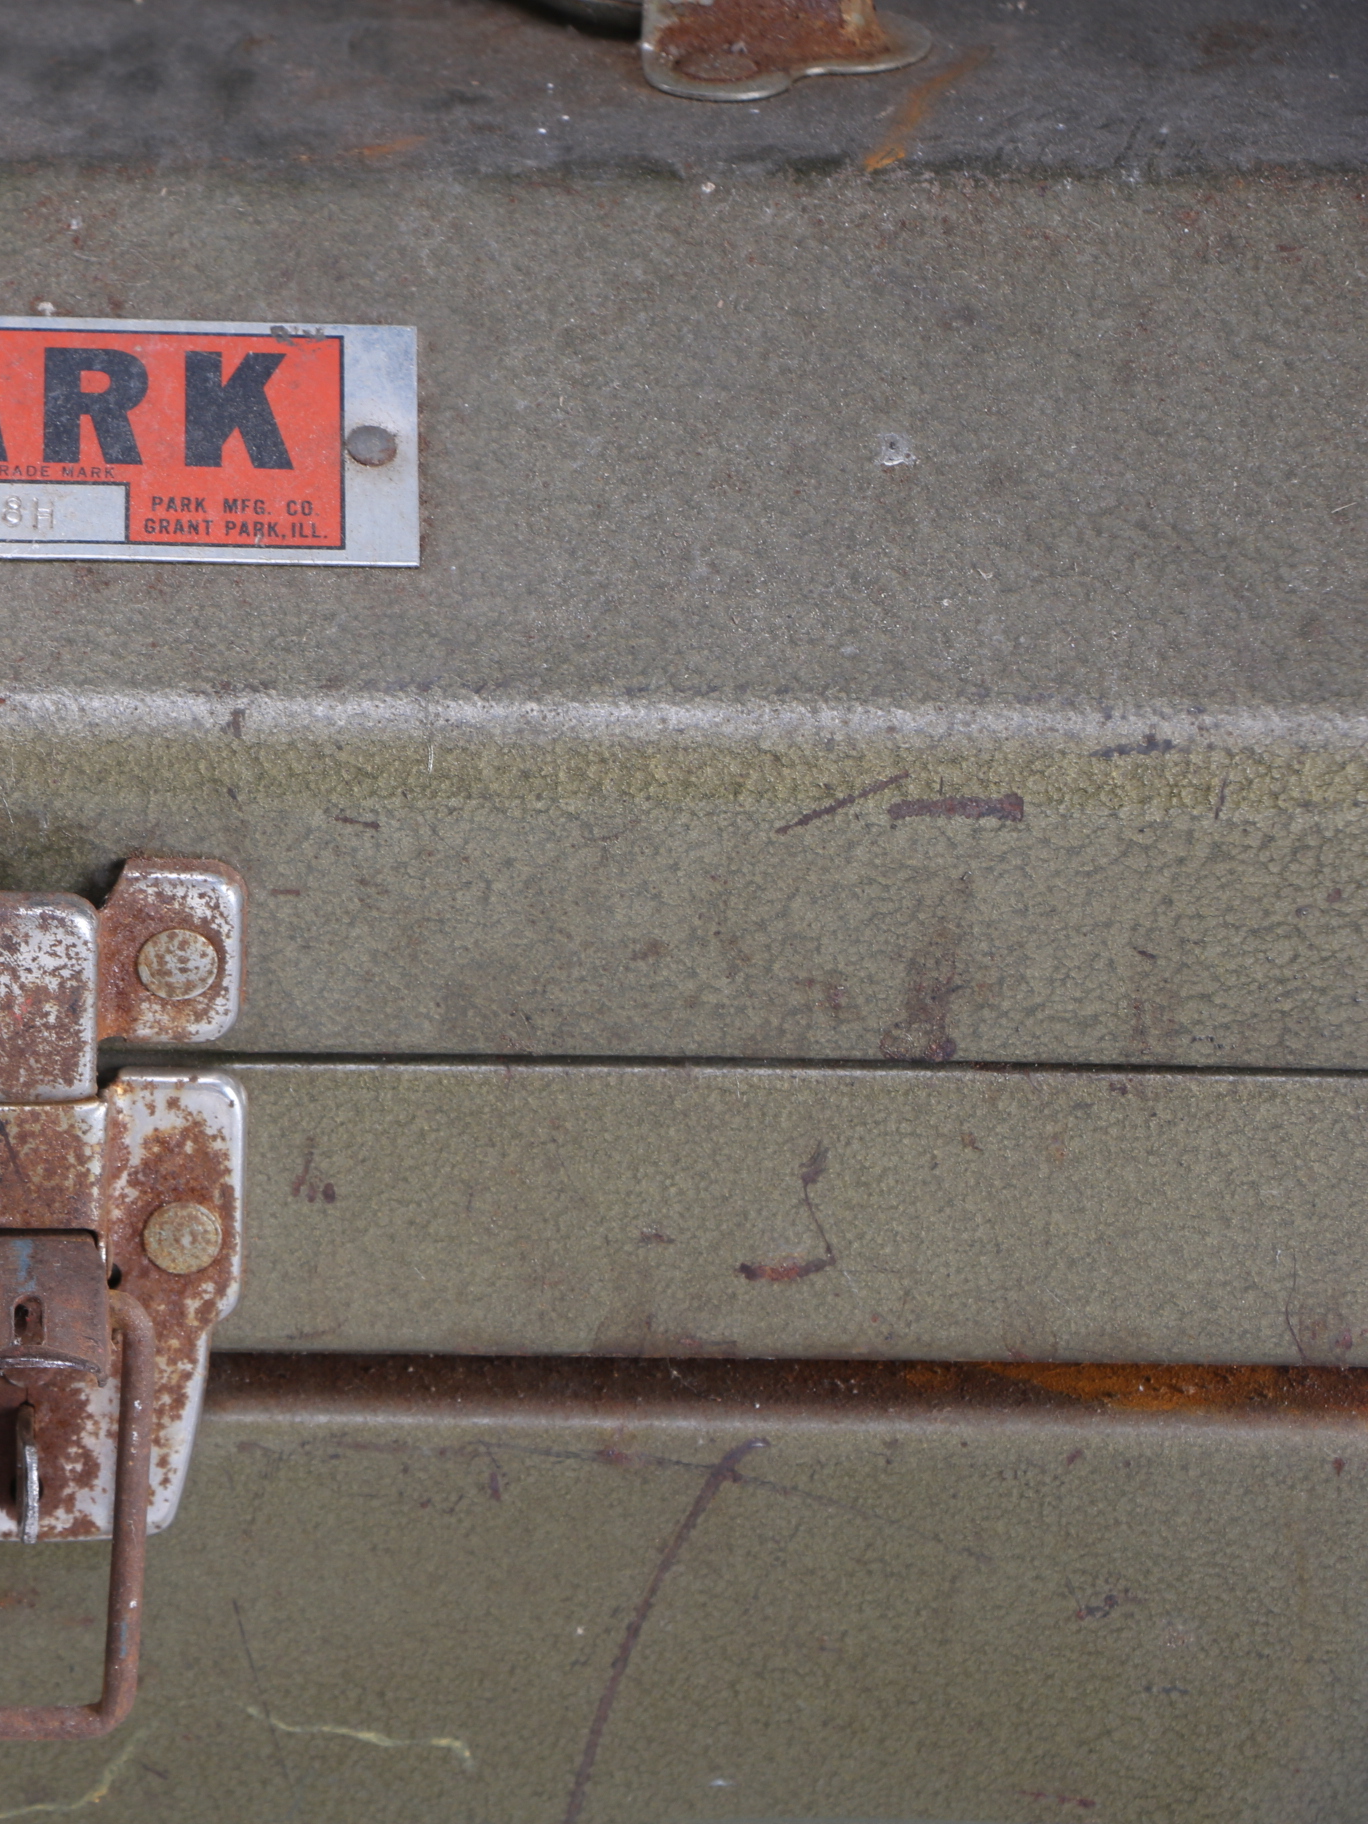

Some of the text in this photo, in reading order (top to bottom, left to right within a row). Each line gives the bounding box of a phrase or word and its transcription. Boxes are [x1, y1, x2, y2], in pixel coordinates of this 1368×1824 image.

[61, 466, 116, 479] MARK
[151, 496, 321, 517] PARK MFG. CO.
[143, 518, 214, 536] GRANT
